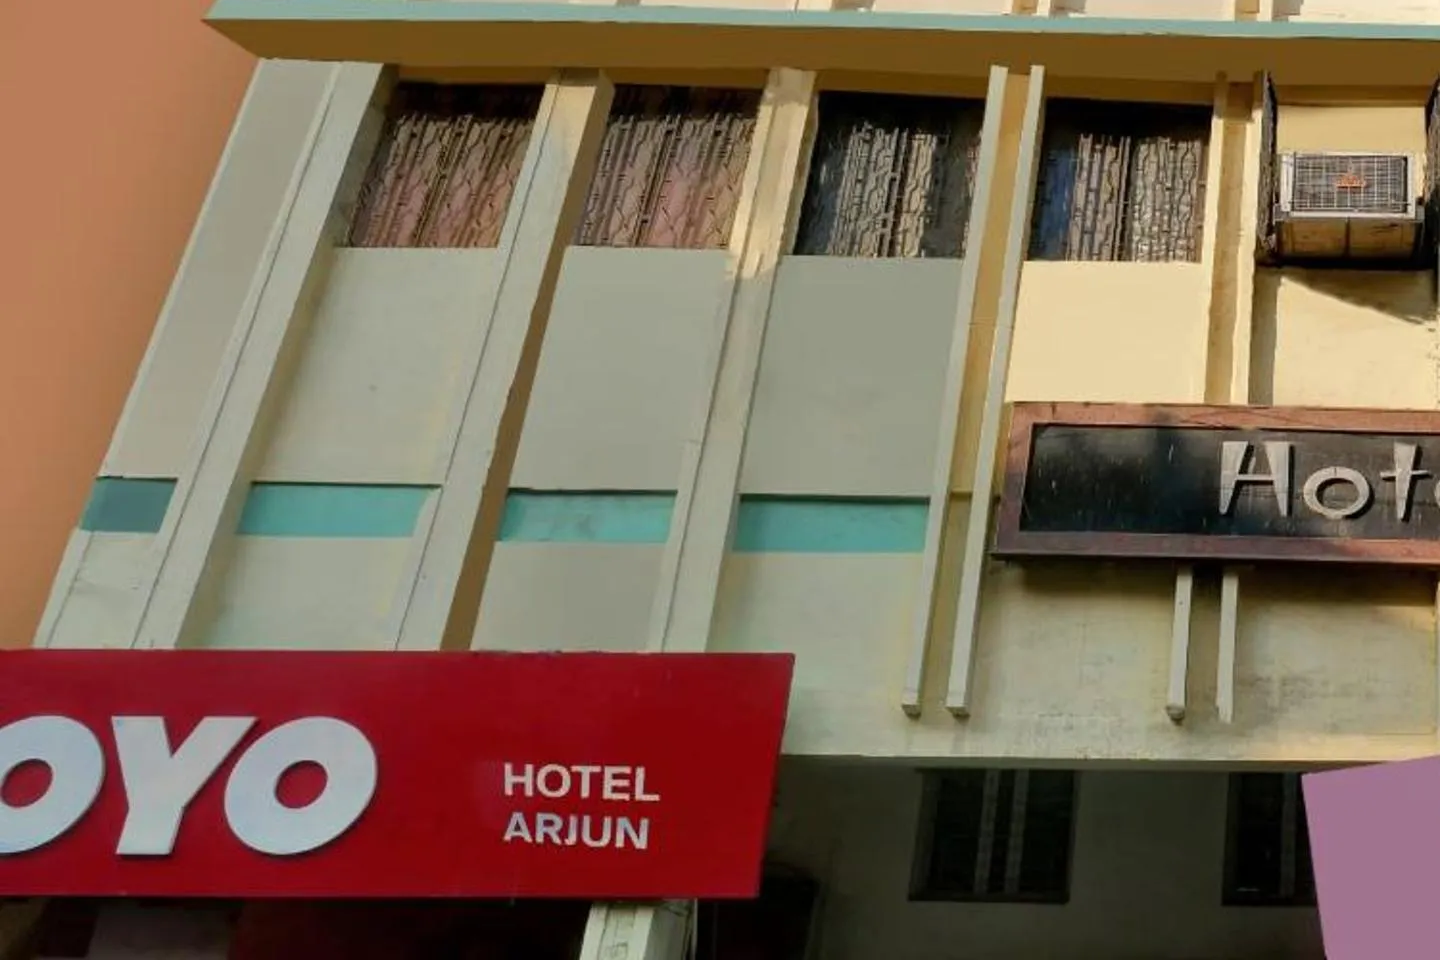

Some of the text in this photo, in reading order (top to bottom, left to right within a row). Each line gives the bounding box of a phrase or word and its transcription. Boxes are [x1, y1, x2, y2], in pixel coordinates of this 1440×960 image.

[0, 715, 378, 856] OYO
[504, 762, 661, 801] HOTEL
[503, 811, 650, 849] ARJUN
